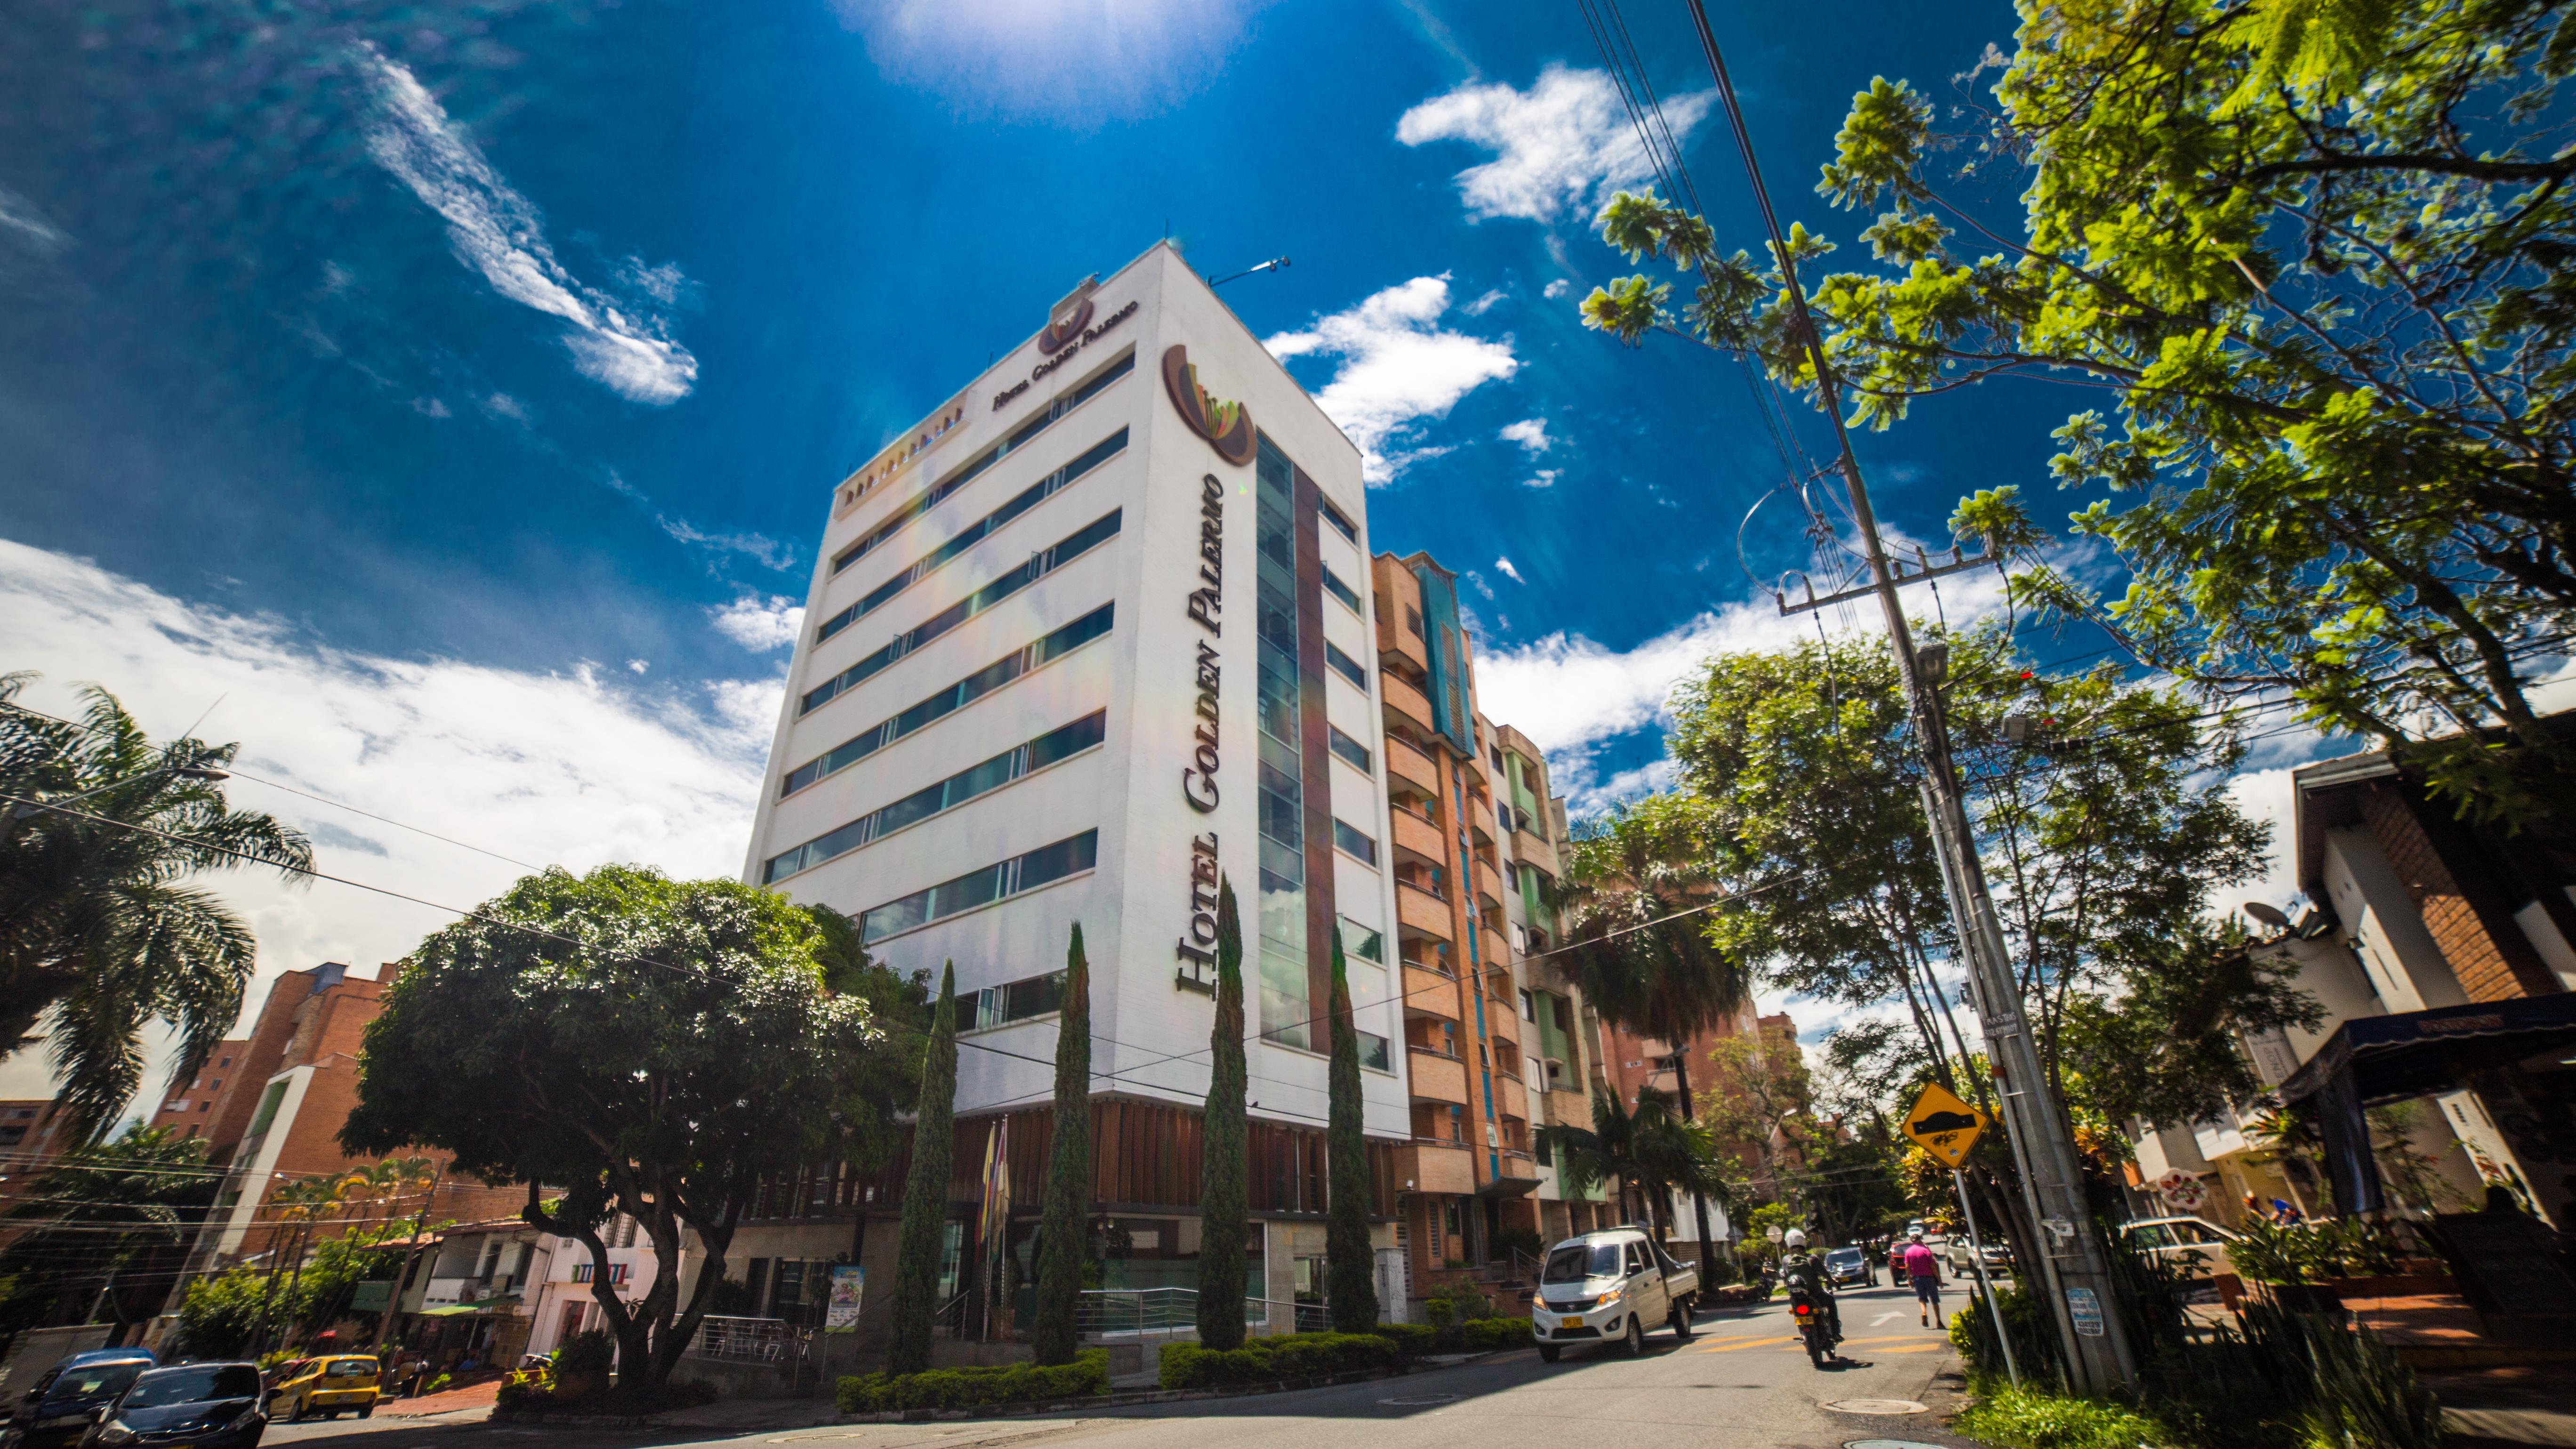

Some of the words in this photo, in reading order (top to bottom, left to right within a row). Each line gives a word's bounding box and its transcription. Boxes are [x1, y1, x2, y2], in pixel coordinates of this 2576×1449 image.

[1032, 342, 1079, 381] GOLDEN
[1081, 301, 1138, 347] PALERMO
[1188, 473, 1224, 639] PALERMO
[1183, 639, 1220, 814] GOLDEN
[1175, 832, 1219, 1002] HOTEL
